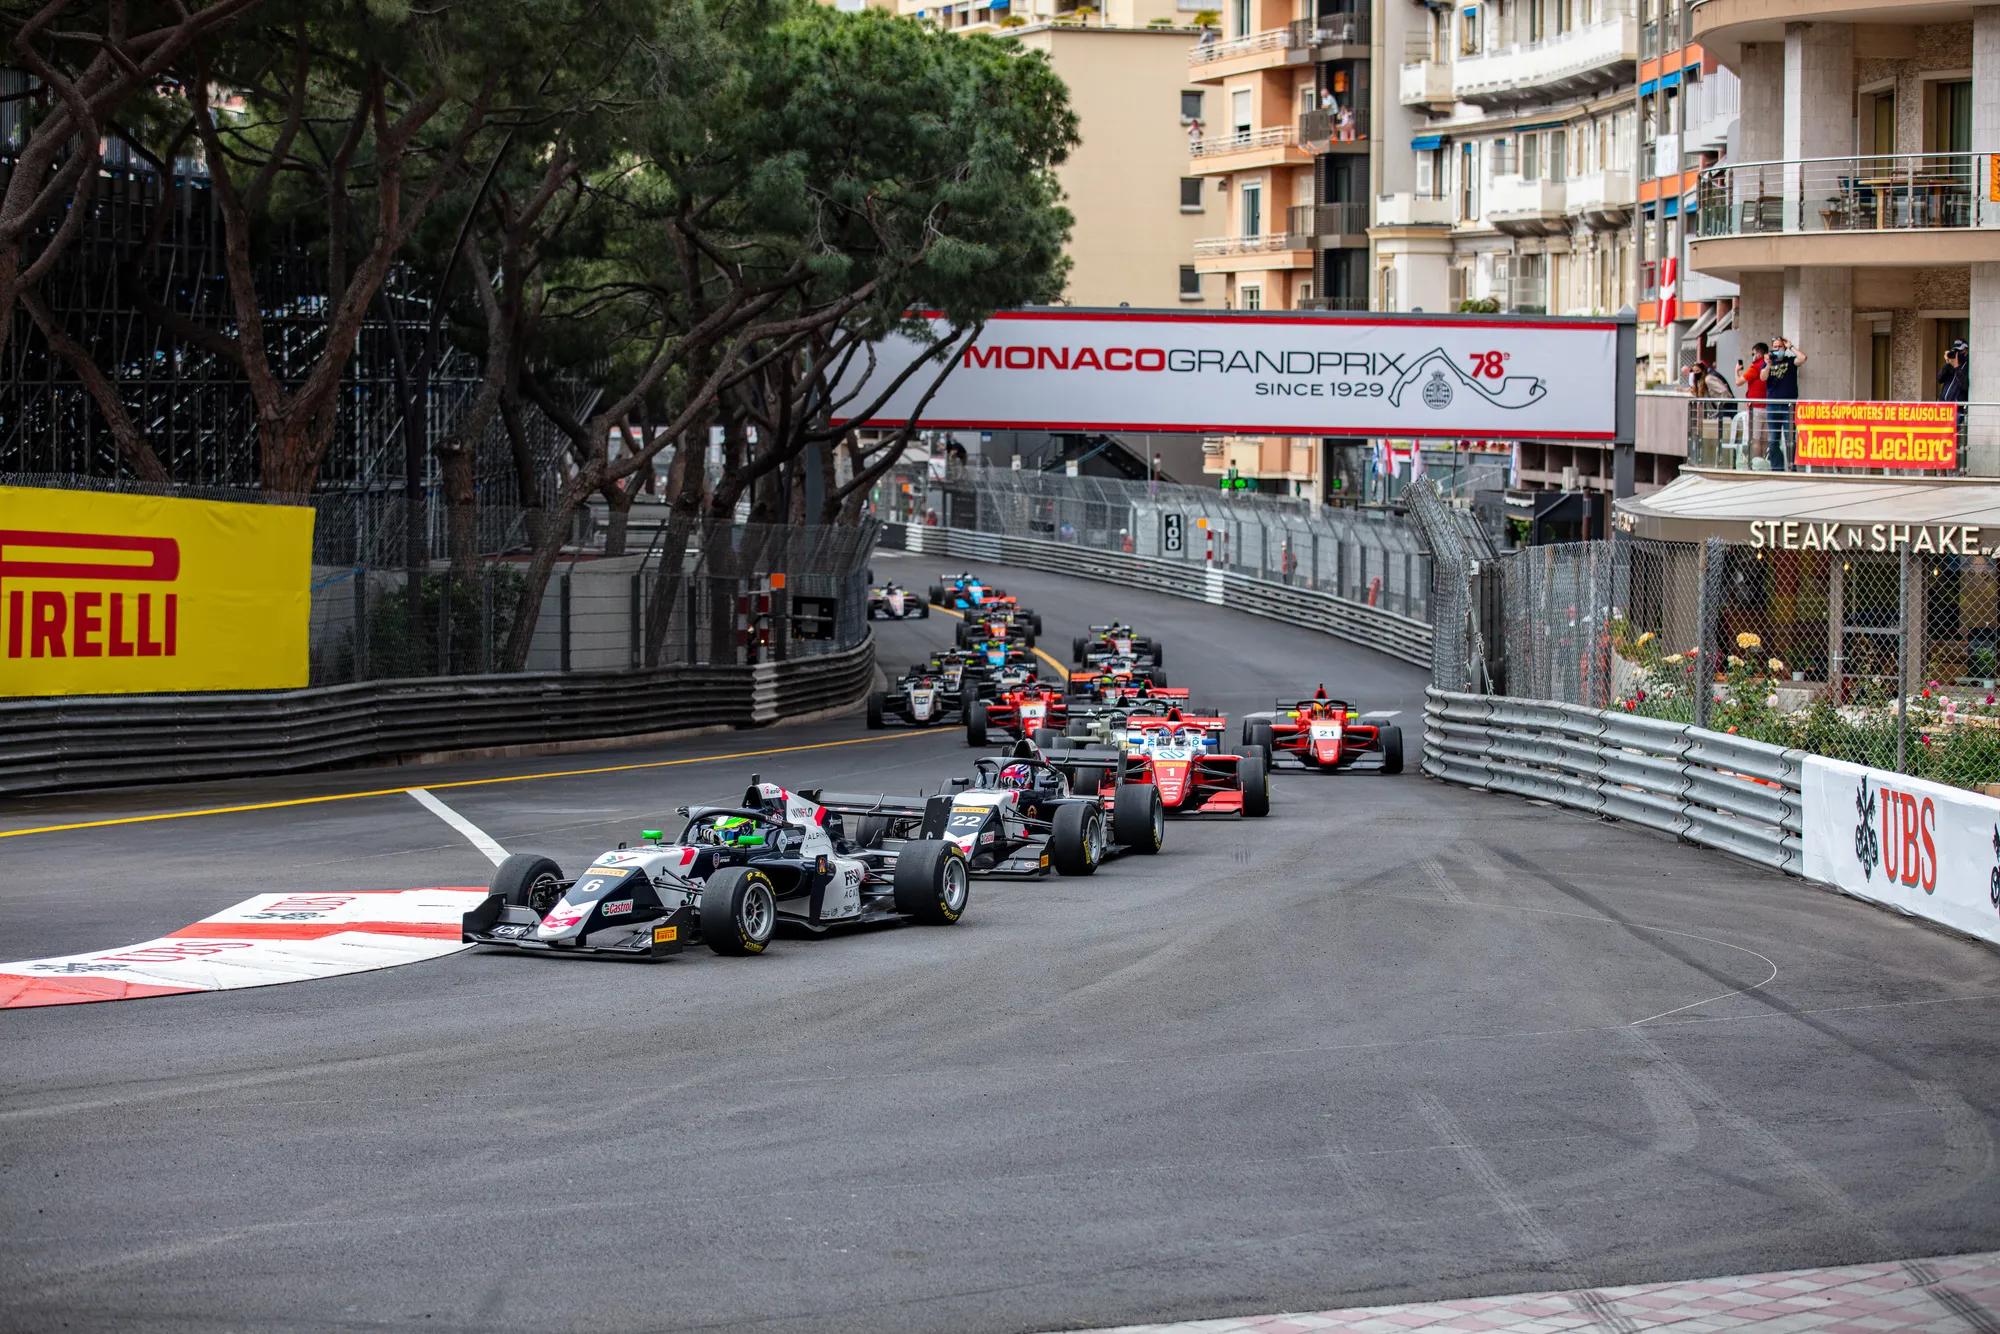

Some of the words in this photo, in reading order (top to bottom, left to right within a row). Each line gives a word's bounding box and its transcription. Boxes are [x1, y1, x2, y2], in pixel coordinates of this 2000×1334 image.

[1255, 382, 1324, 396] SINCE
[1331, 382, 1384, 398] 1929
[1797, 405, 1816, 419] CLUB
[1816, 406, 1831, 419] DES
[1831, 405, 1883, 420] SUPPORTERS
[1884, 406, 1897, 420] DE
[1898, 406, 1954, 422] BEAUSOLEIL
[1797, 424, 1867, 460] Charles
[1870, 425, 1954, 461] Leclerc
[1750, 521, 1840, 550] STEAK
[1848, 528, 1862, 548] N
[1871, 524, 1980, 555] SHAKE
[951, 815, 982, 827] 22
[1880, 787, 1938, 896] UBS
[582, 879, 604, 892] 6
[609, 900, 633, 914] Castrol
